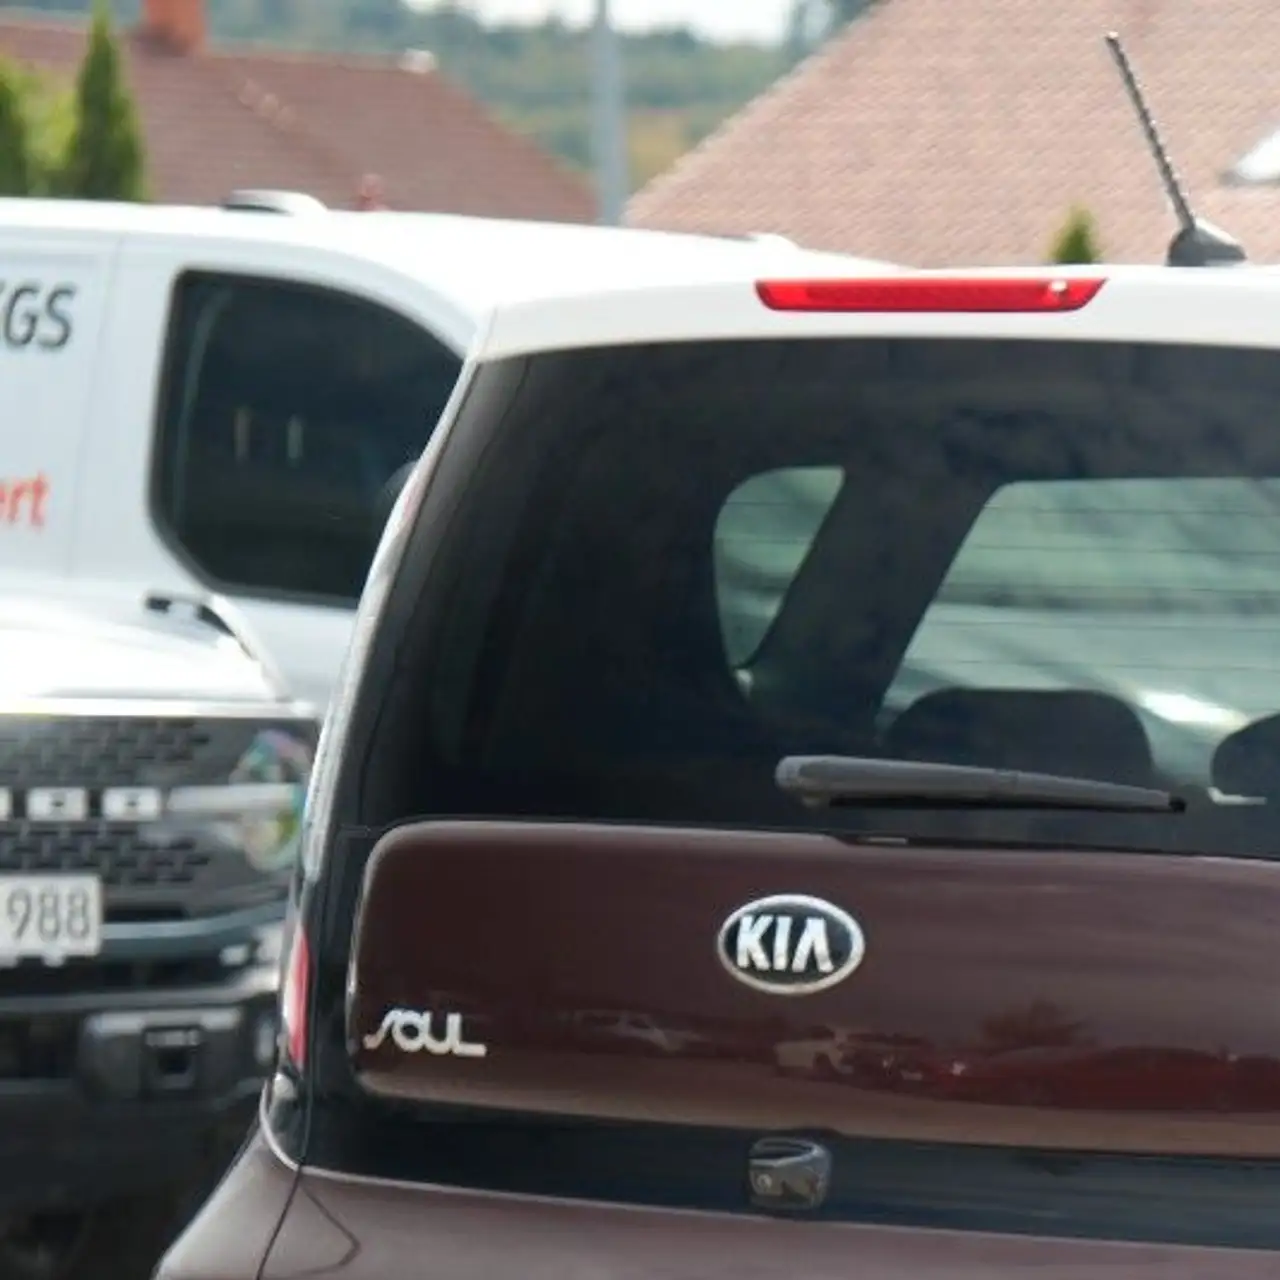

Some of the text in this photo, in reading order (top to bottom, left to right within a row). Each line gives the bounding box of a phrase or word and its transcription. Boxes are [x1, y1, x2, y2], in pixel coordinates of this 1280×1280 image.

[0, 282, 76, 351] GS
[6, 887, 90, 941] 988
[736, 914, 835, 972] KIA
[363, 1008, 487, 1057] SOUL
